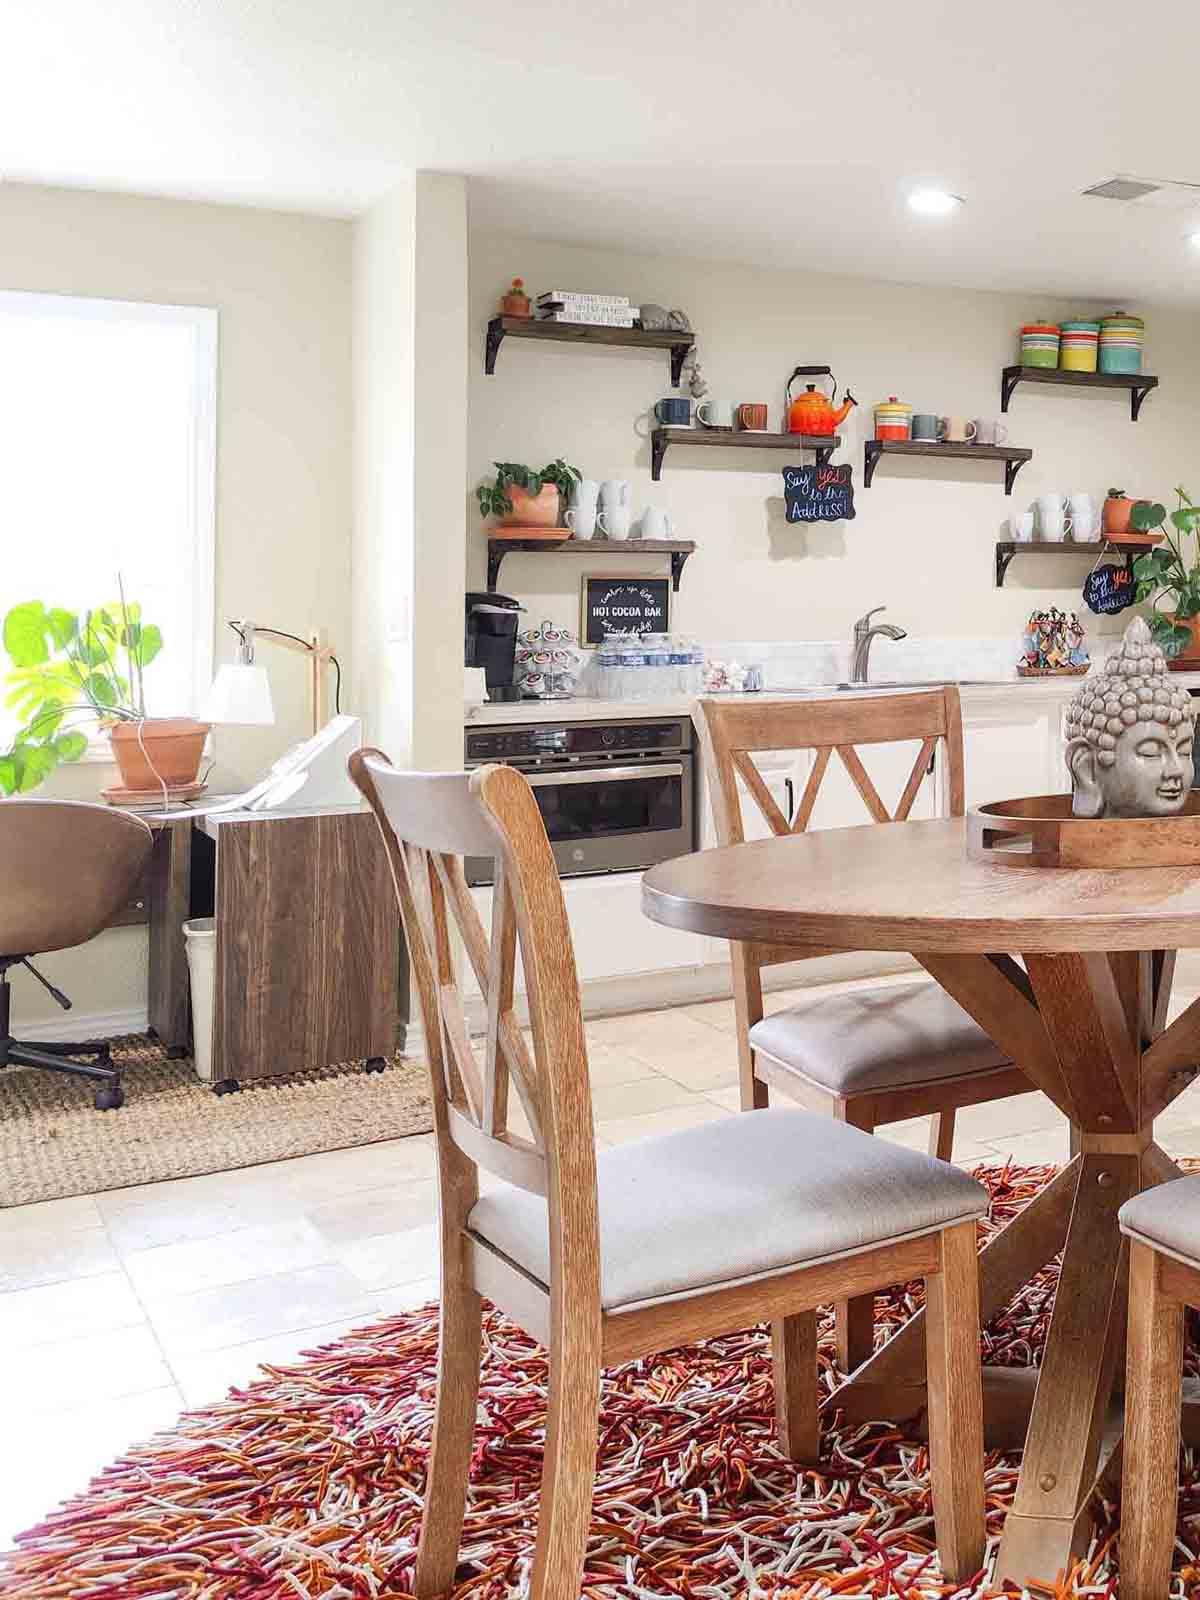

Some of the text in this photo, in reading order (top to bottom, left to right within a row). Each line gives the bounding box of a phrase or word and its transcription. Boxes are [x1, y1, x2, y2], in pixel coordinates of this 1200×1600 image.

[787, 472, 809, 495] Say
[809, 488, 822, 501] to
[592, 607, 661, 617] HOT COCOA BAR
